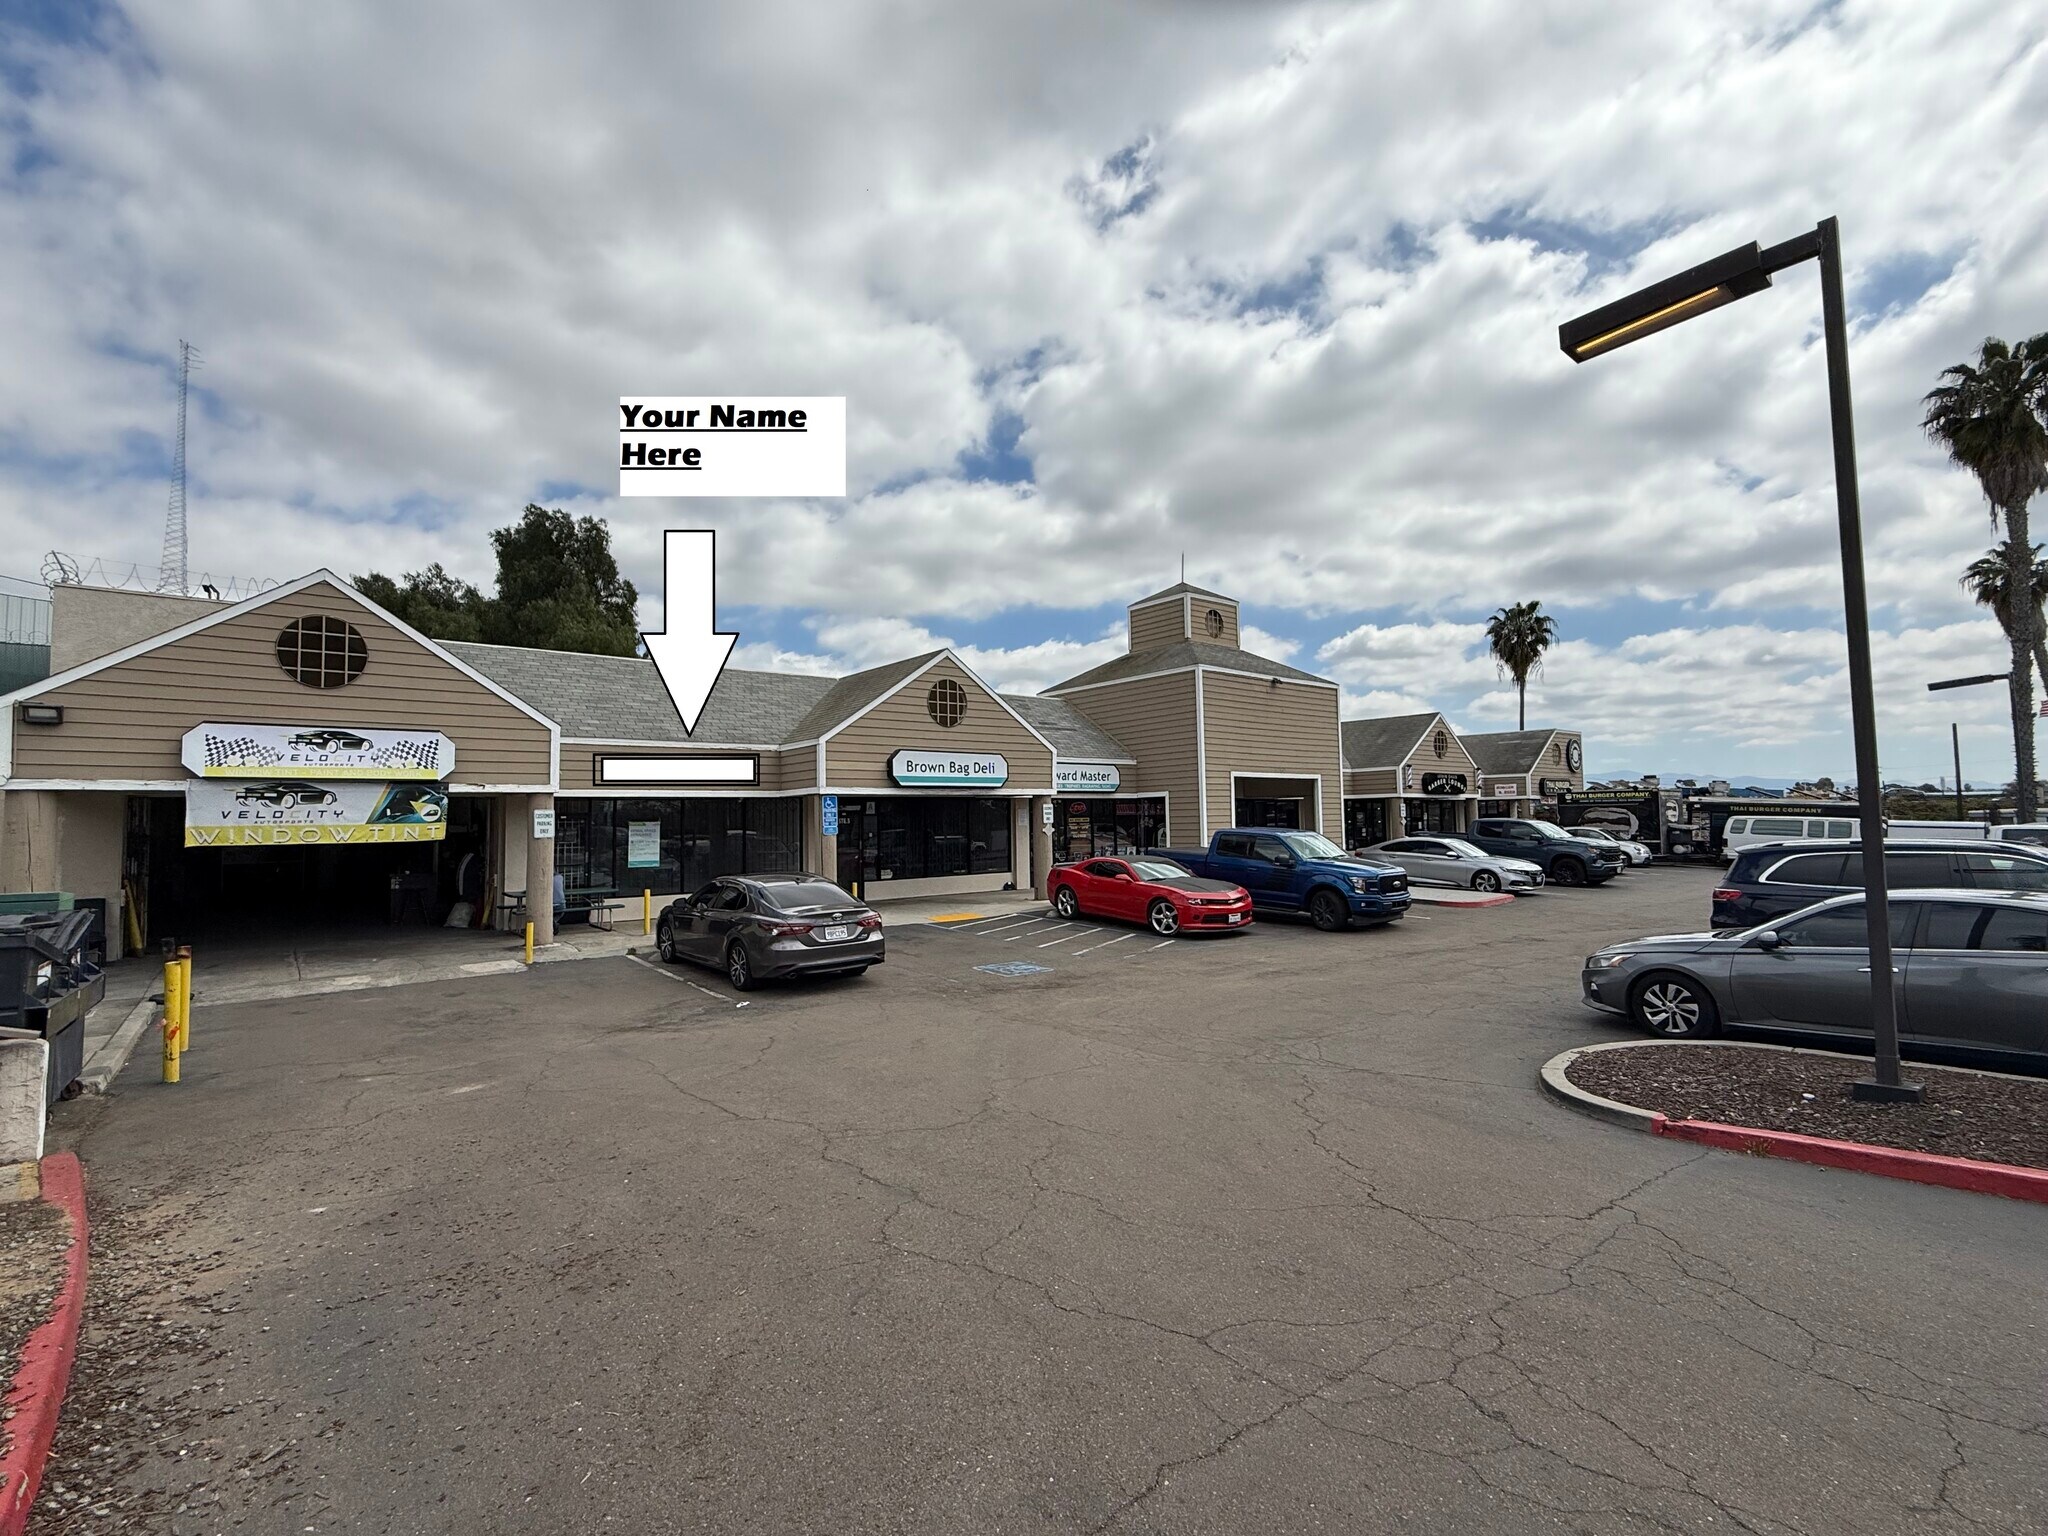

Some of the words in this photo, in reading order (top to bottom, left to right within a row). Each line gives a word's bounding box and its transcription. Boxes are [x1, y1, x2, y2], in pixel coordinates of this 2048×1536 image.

[276, 754, 379, 763] VELOCITY
[225, 768, 272, 776] WINDOW
[906, 760, 945, 773] Brown
[949, 761, 970, 776] Bag
[973, 762, 995, 774] Deli
[1056, 770, 1077, 781] ward
[1080, 771, 1111, 782] Master
[1428, 778, 1447, 791] BARBER
[221, 810, 344, 820] VELOCITY
[189, 827, 356, 845] WINDOW
[369, 826, 441, 842] TINT
